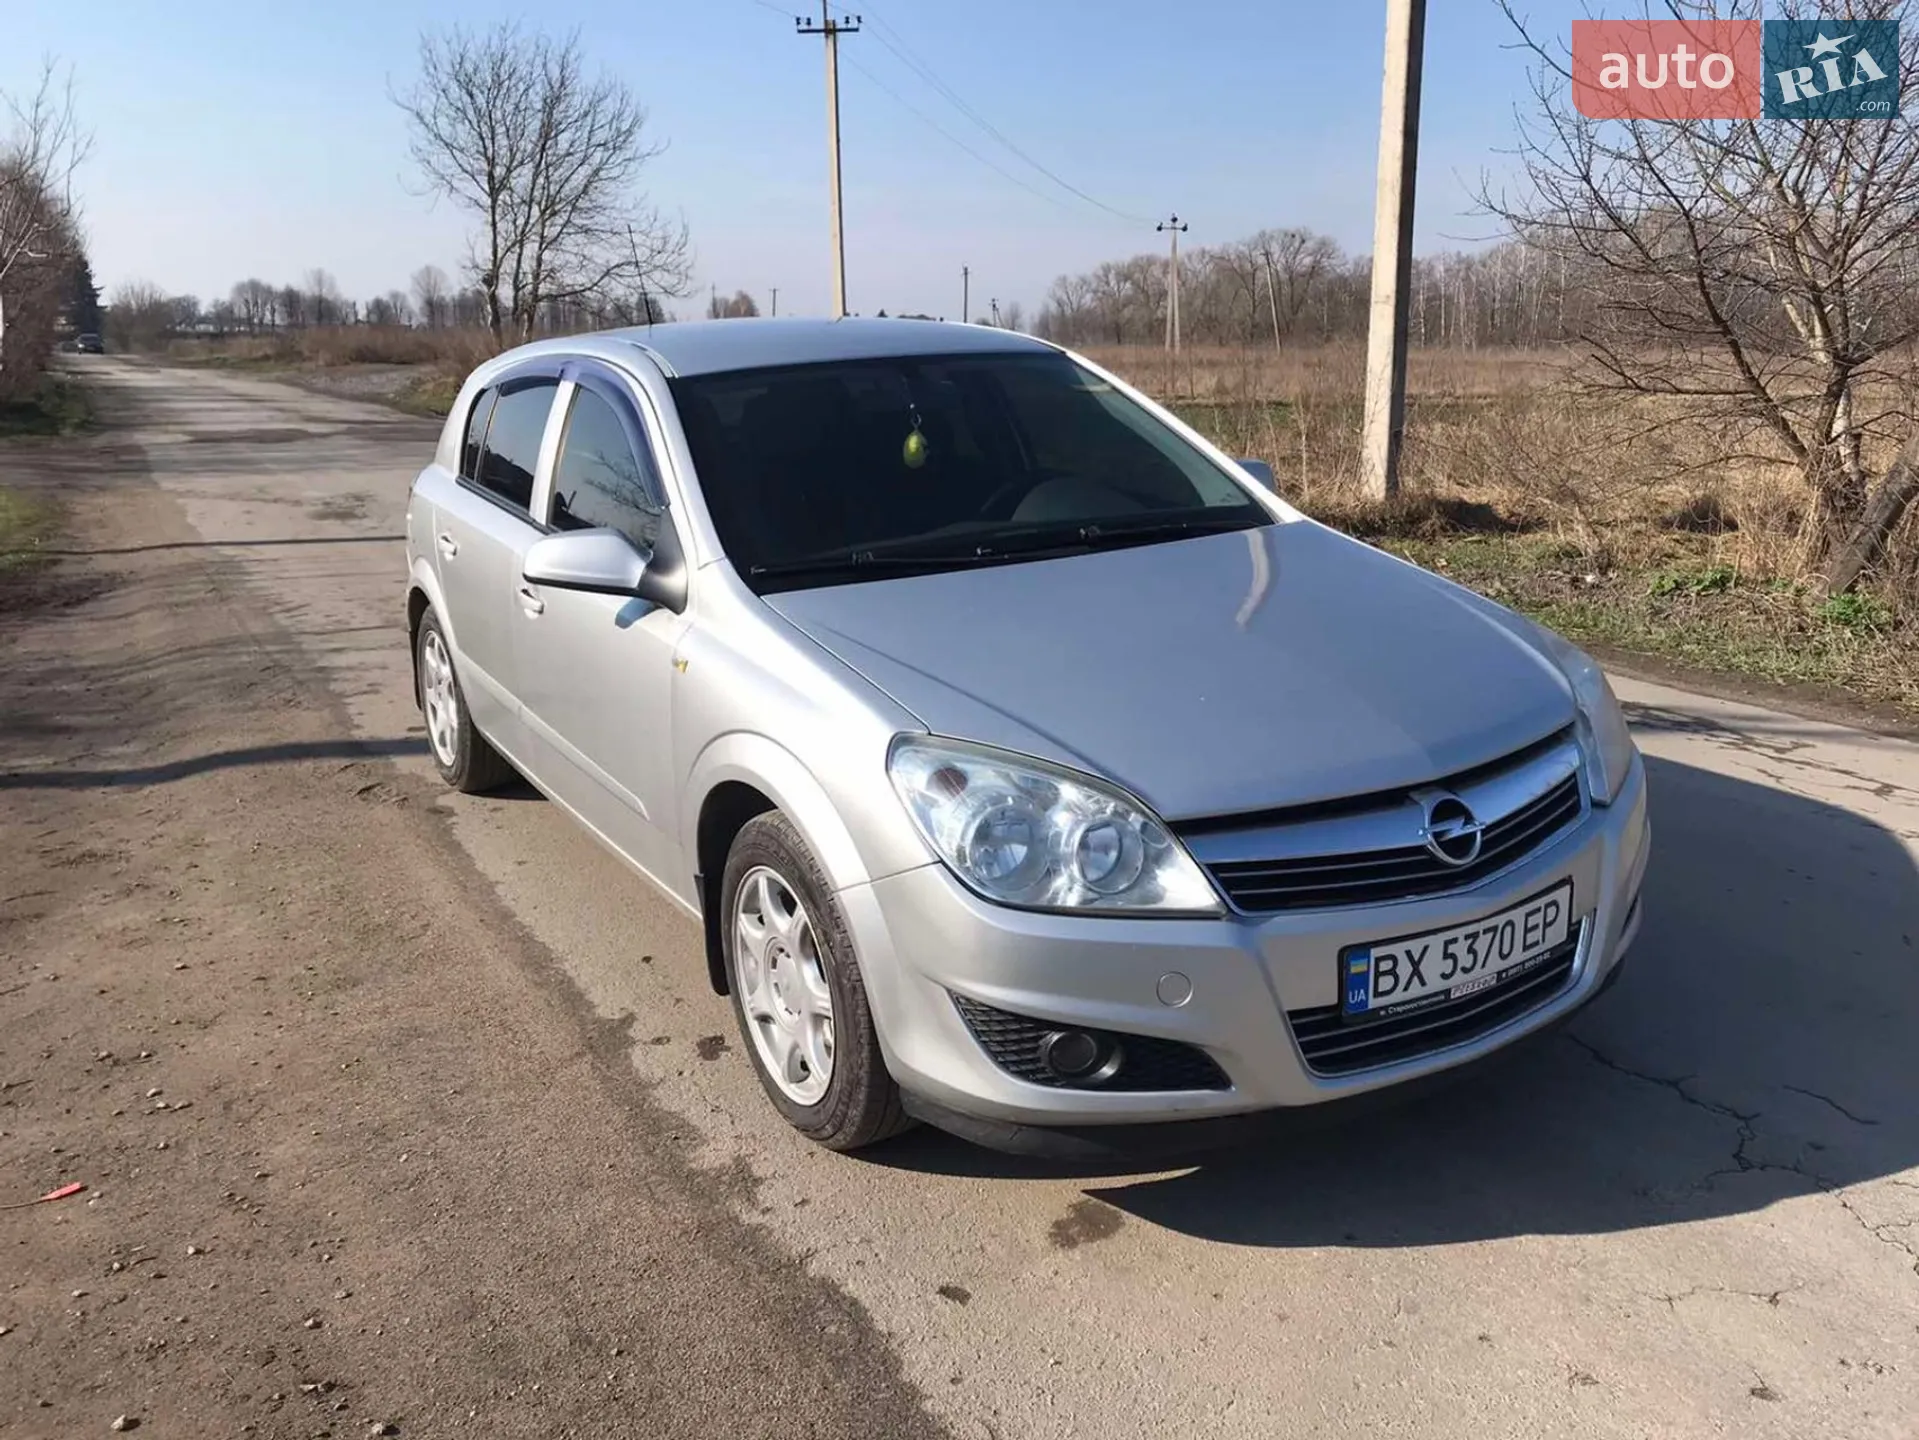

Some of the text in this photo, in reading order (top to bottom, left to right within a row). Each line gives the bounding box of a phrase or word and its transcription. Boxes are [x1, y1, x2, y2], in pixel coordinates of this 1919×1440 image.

[1373, 944, 1430, 999] BX
[1439, 919, 1516, 981] 5370
[1521, 899, 1560, 952] EP
[1349, 989, 1366, 1004] UA
